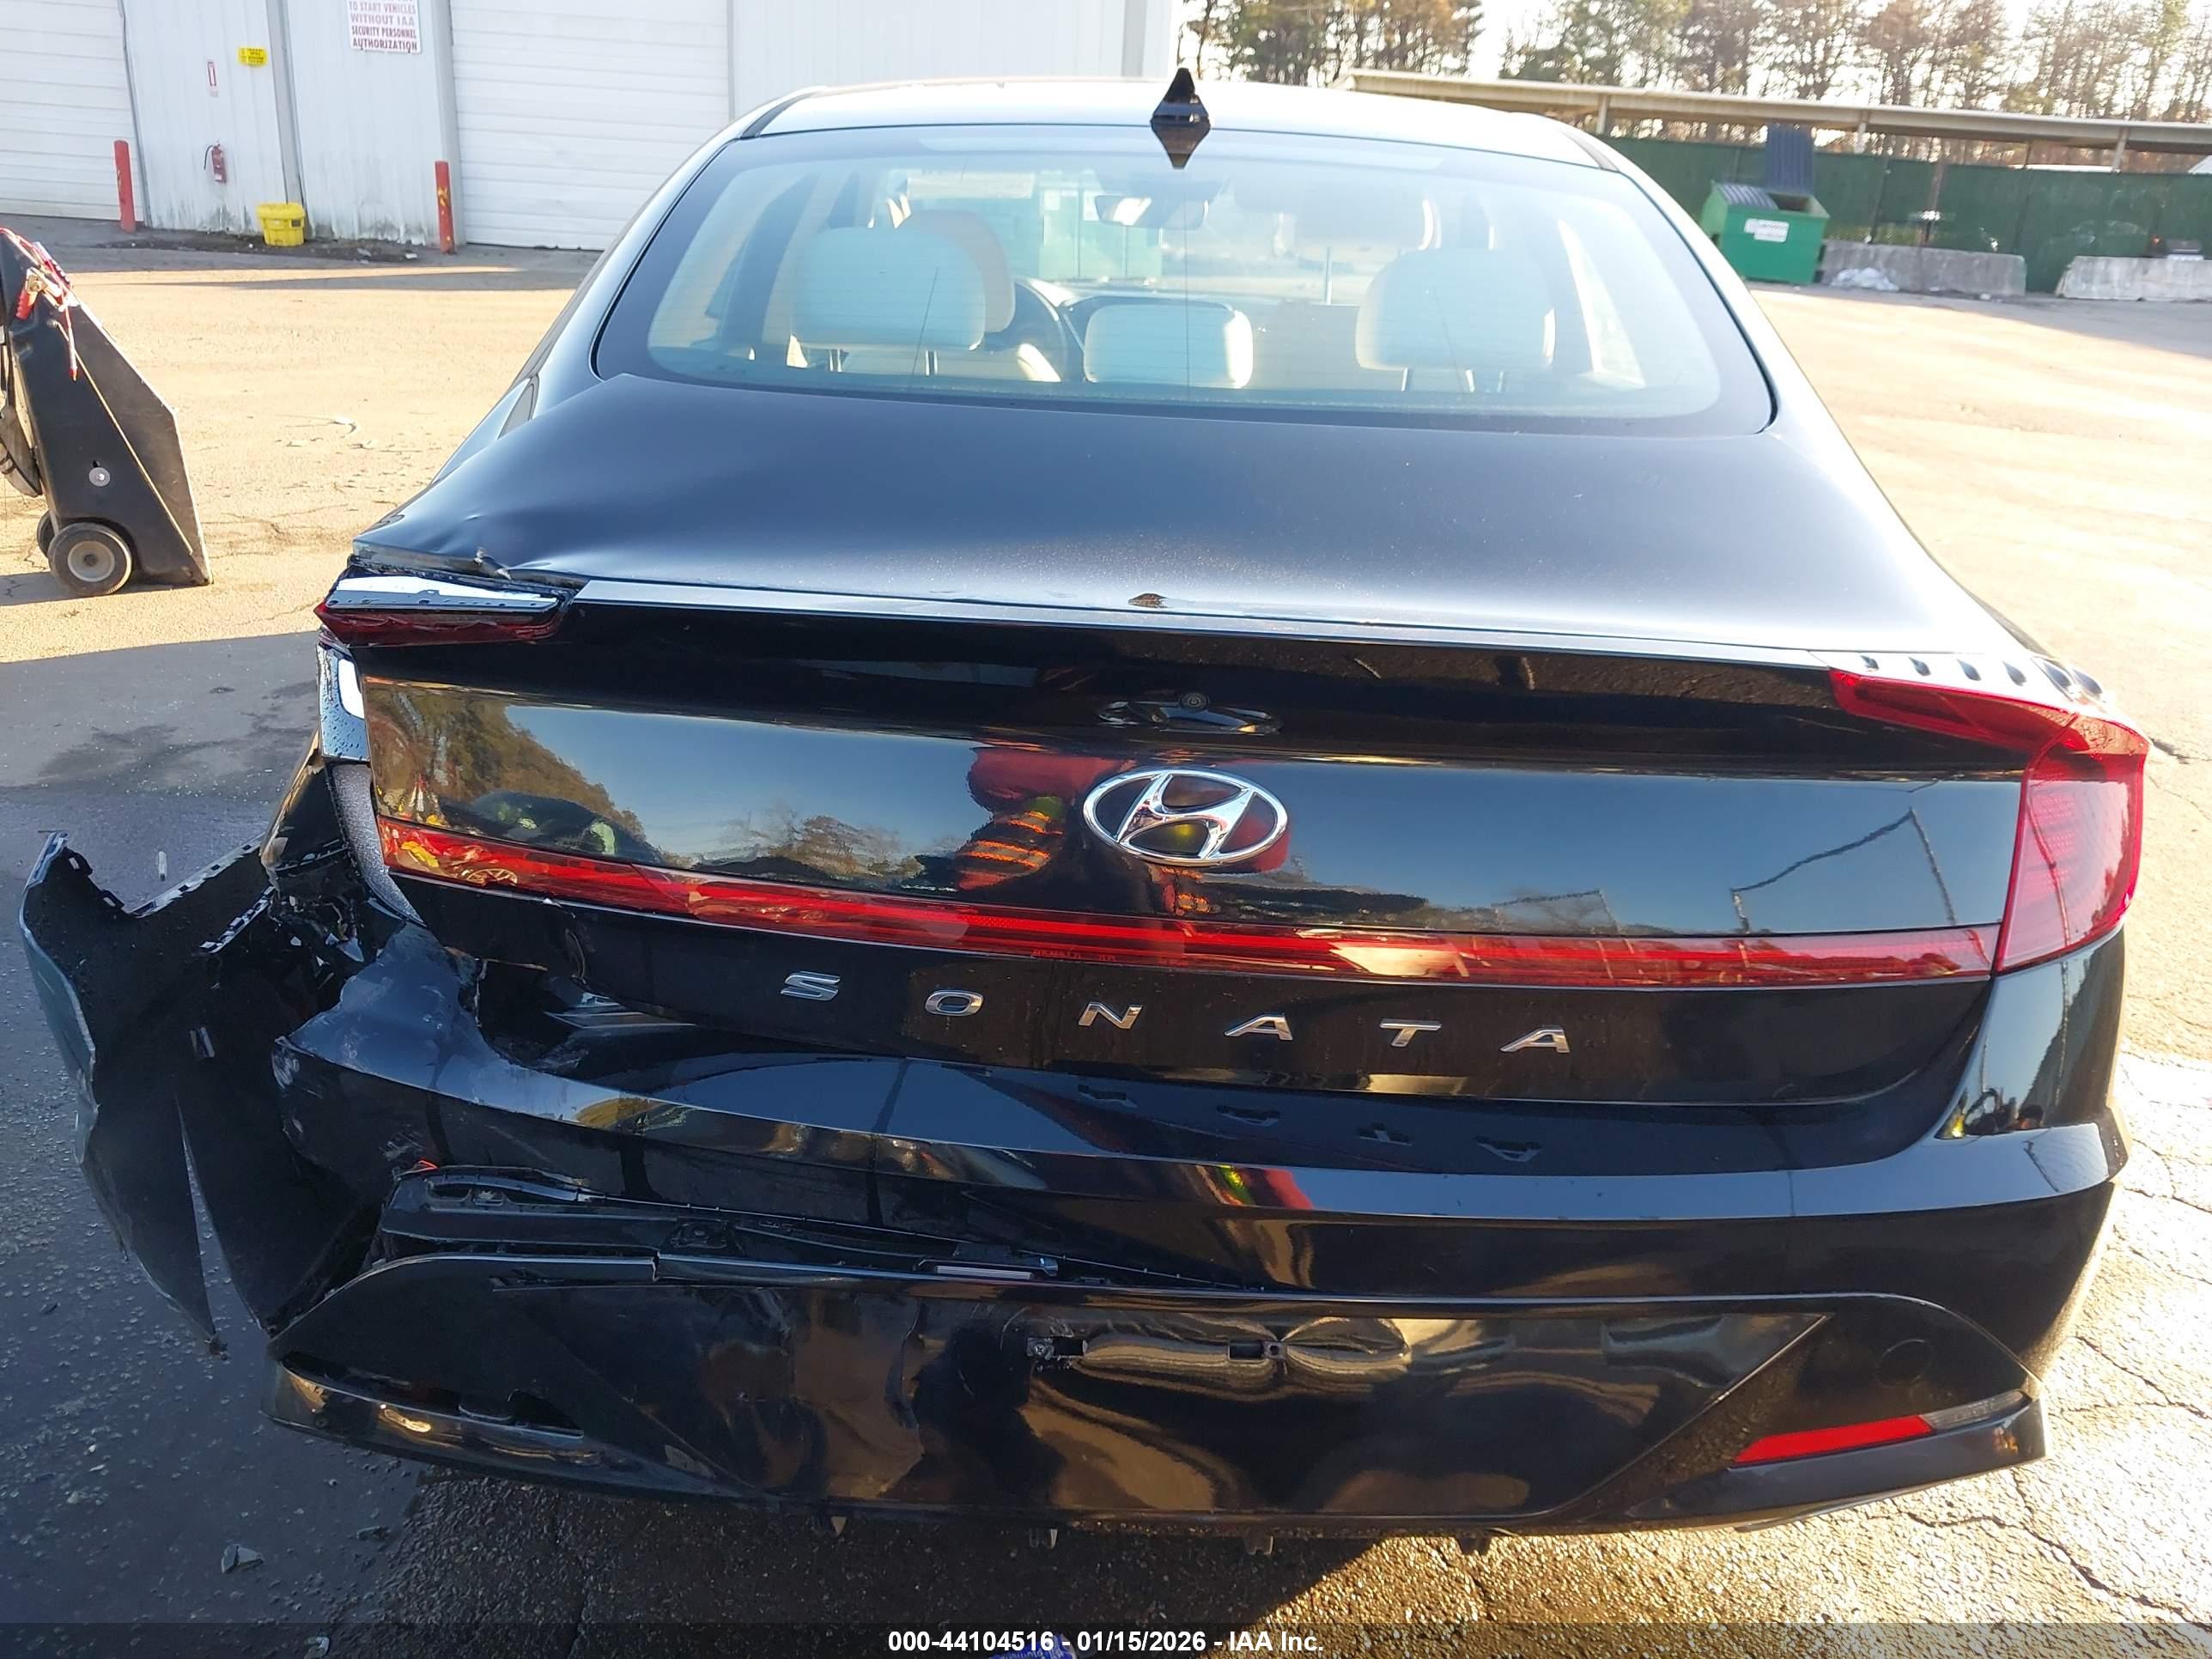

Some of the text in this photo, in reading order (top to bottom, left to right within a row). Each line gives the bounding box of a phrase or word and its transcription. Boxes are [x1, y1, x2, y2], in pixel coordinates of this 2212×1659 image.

[349, 2, 416, 15] TO START VEHICLES
[350, 14, 415, 26] WITHOUT IAA
[351, 26, 416, 39] SECURITY PERSONNEL
[353, 38, 417, 52] AUTHORIZATION
[780, 970, 1570, 1054] SONATA
